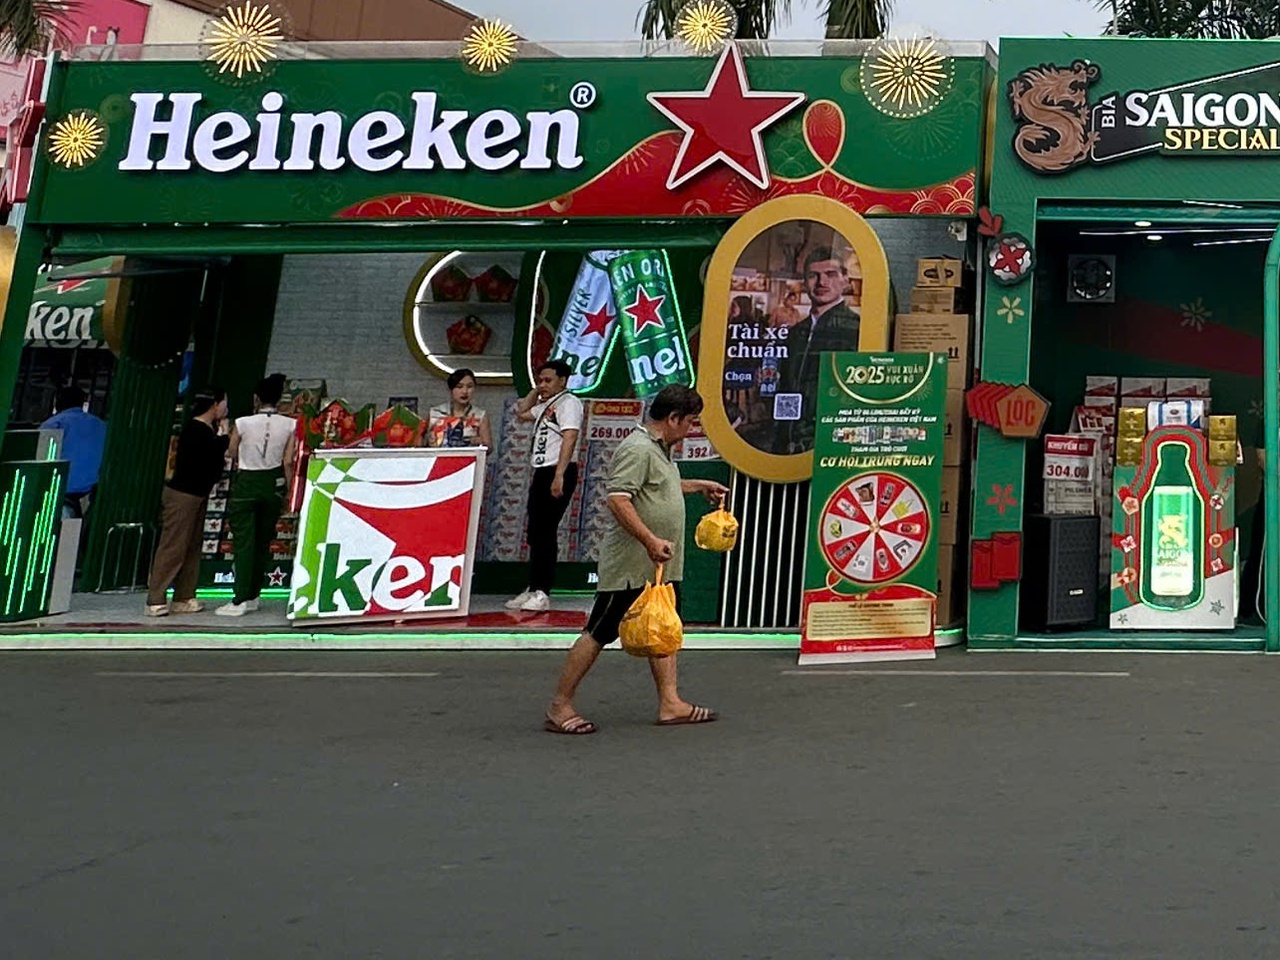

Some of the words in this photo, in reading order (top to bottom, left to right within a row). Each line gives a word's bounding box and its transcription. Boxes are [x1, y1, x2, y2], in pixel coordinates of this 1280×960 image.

[1101, 96, 1117, 128] BIA
[118, 91, 584, 172] Heineken
[565, 290, 591, 338] SILVER
[728, 323, 760, 339] Tài
[727, 340, 789, 358] chuẩn
[591, 426, 636, 439] 269.00
[820, 456, 837, 467] CƠ
[902, 455, 935, 467] NGAY
